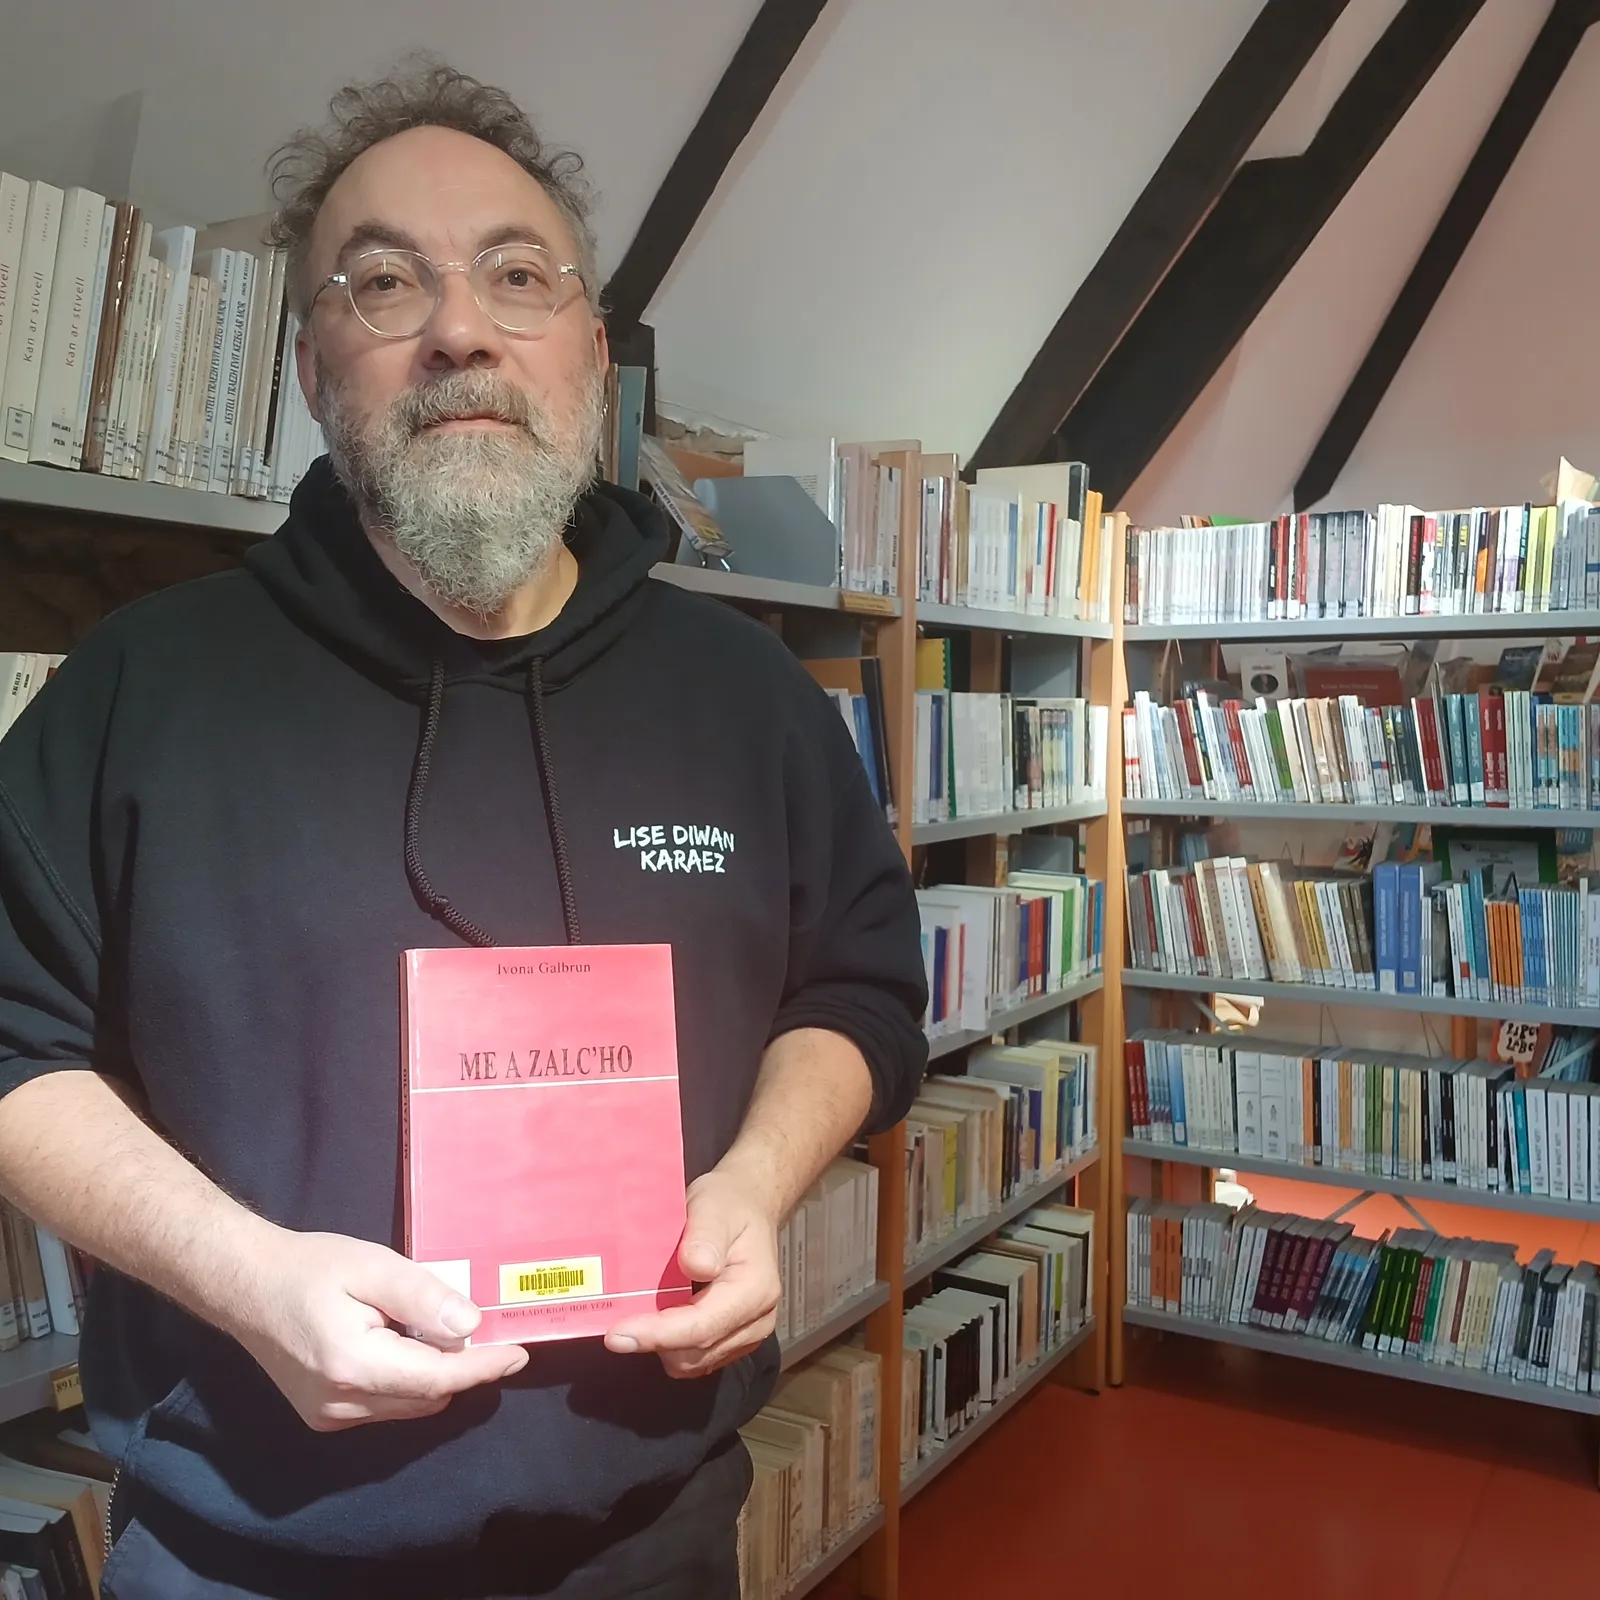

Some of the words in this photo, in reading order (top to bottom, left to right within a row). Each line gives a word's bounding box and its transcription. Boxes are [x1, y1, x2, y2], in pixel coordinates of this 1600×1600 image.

[31, 271, 44, 314] stivell
[73, 277, 85, 319] stivell
[216, 314, 225, 327] AR
[237, 301, 247, 317] MOR
[29, 317, 38, 333] ar
[71, 323, 79, 338] ar
[236, 316, 245, 331] AR
[213, 326, 224, 350] KEZEG
[233, 329, 243, 353] KEZEG
[23, 338, 35, 363] Kan
[65, 342, 77, 367] Kan
[232, 353, 241, 370] EVIT
[207, 365, 219, 394] TRAEZH
[227, 368, 239, 397] TRAEZH
[205, 398, 217, 423] KESTELL
[224, 398, 236, 426] KESTELL
[614, 825, 666, 849] LISE
[672, 825, 734, 852] DIWAN
[641, 849, 725, 873] KARAEZ
[497, 963, 534, 975] Ivona
[538, 962, 591, 974] Galbrun
[459, 1051, 498, 1080] ME
[505, 1050, 522, 1078] A
[529, 1045, 633, 1077] ZALC'HO
[570, 1303, 588, 1312] HOR
